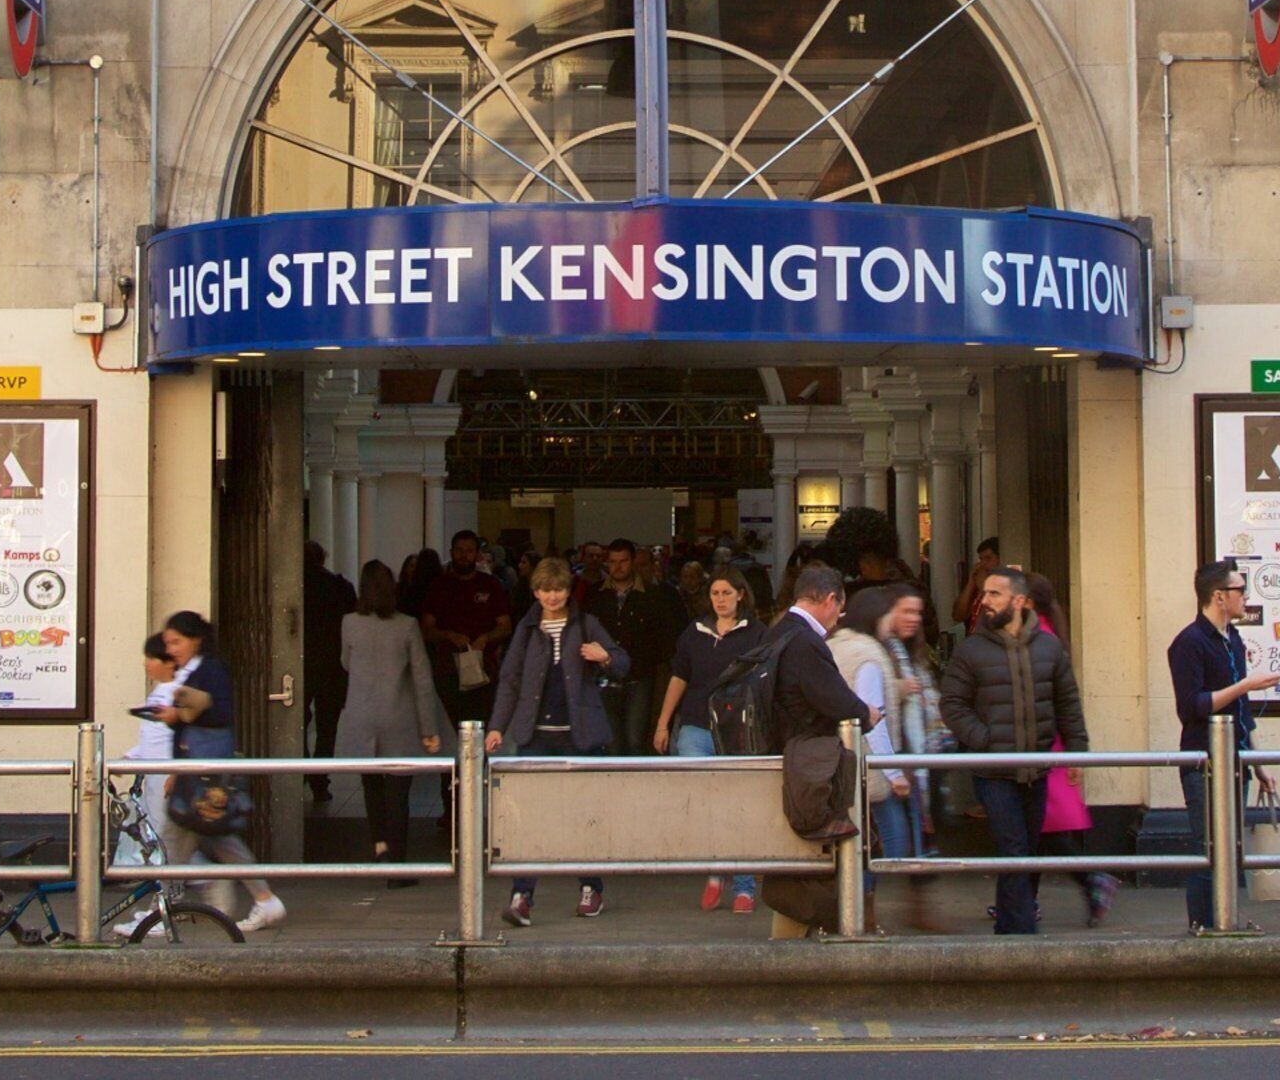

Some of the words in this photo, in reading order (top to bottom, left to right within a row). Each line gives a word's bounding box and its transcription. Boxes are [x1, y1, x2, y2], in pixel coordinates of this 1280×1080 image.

[169, 257, 249, 319] HIGH
[266, 246, 473, 309] STREET
[501, 242, 956, 304] KENSINGTON
[981, 250, 1129, 317] STATION
[3, 548, 41, 562] Kamps
[35, 665, 67, 673] NERO
